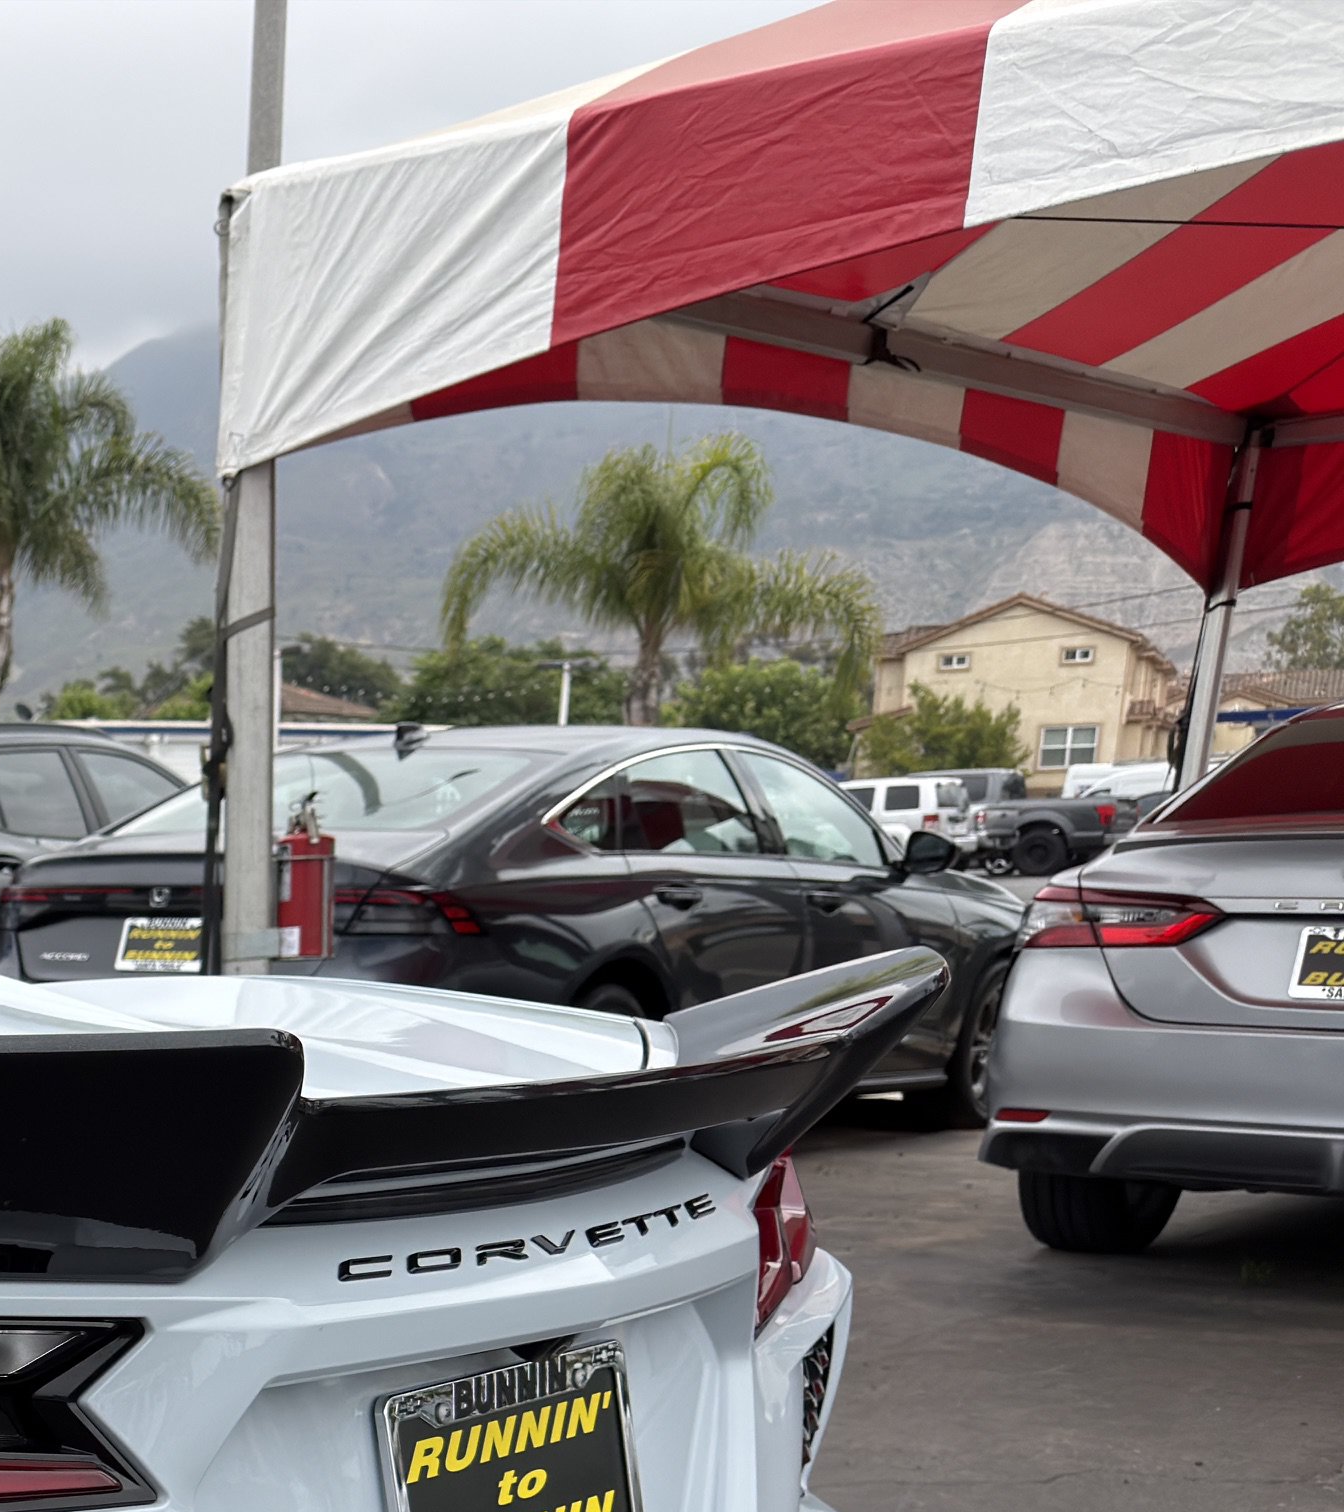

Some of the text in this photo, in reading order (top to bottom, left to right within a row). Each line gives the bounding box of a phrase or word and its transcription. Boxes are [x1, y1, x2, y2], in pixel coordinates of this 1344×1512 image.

[338, 1193, 717, 1283] CORVETTE
[452, 1357, 567, 1419] BUNNIN
[406, 1390, 612, 1485] RUNNIN'
[496, 1468, 548, 1507] to
